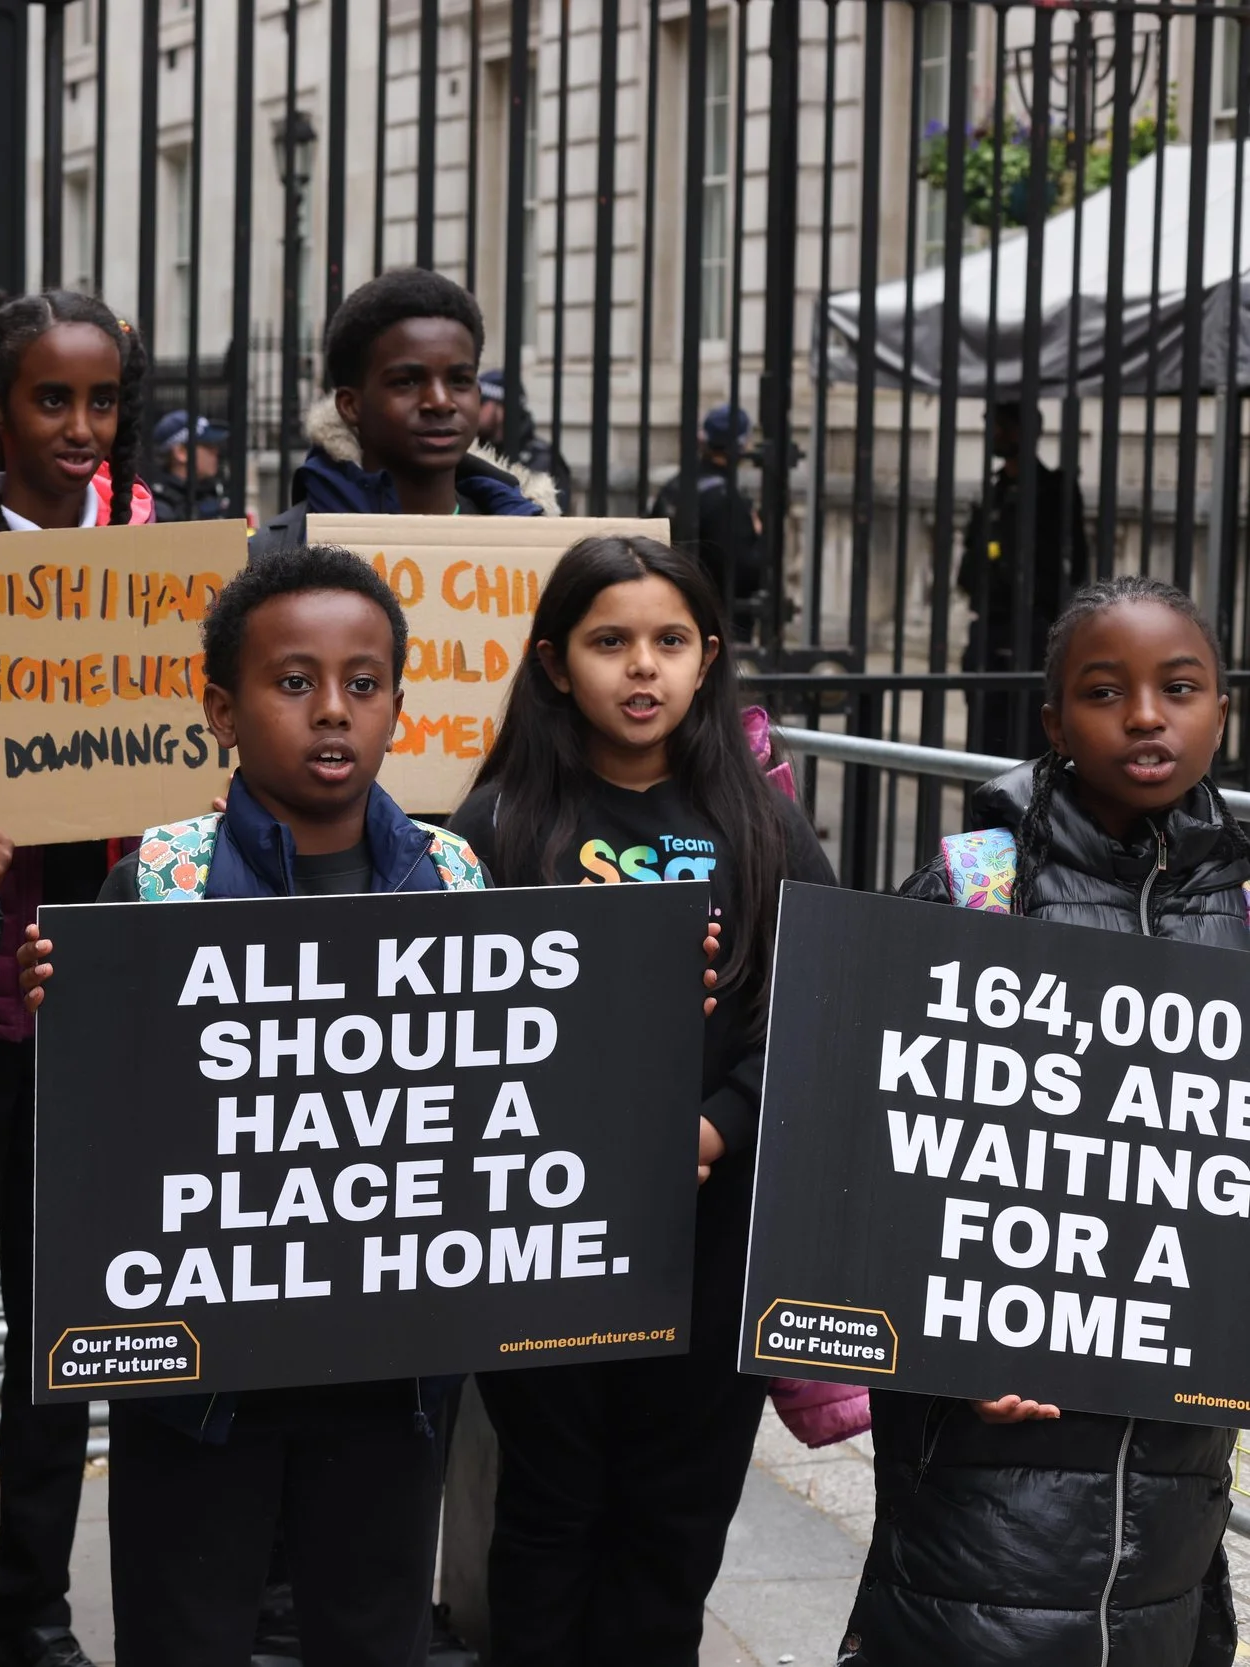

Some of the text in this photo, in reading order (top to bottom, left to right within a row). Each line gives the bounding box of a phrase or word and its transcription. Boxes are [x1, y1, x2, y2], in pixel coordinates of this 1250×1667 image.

[4, 724, 180, 778] DOWNING
[659, 834, 715, 853] Team
[178, 931, 579, 1005] ALL KIDS
[199, 1007, 557, 1080] SHOULD
[925, 960, 1243, 1061] 164,000
[218, 1081, 539, 1154] HAVE A
[879, 1030, 1250, 1141] KIDS ARE
[163, 1151, 585, 1232] PLACE TO
[886, 1109, 1250, 1219] WAITING
[106, 1221, 629, 1309] CALL HOME.
[941, 1198, 1190, 1288] FOR A
[73, 1336, 177, 1353] Our Home
[500, 1327, 676, 1353] ourhomeourfutures.org
[769, 1333, 884, 1360] Our Futures
[780, 1311, 877, 1336] Our Home
[922, 1274, 1192, 1367] HOME.
[62, 1357, 187, 1376] Our Futures
